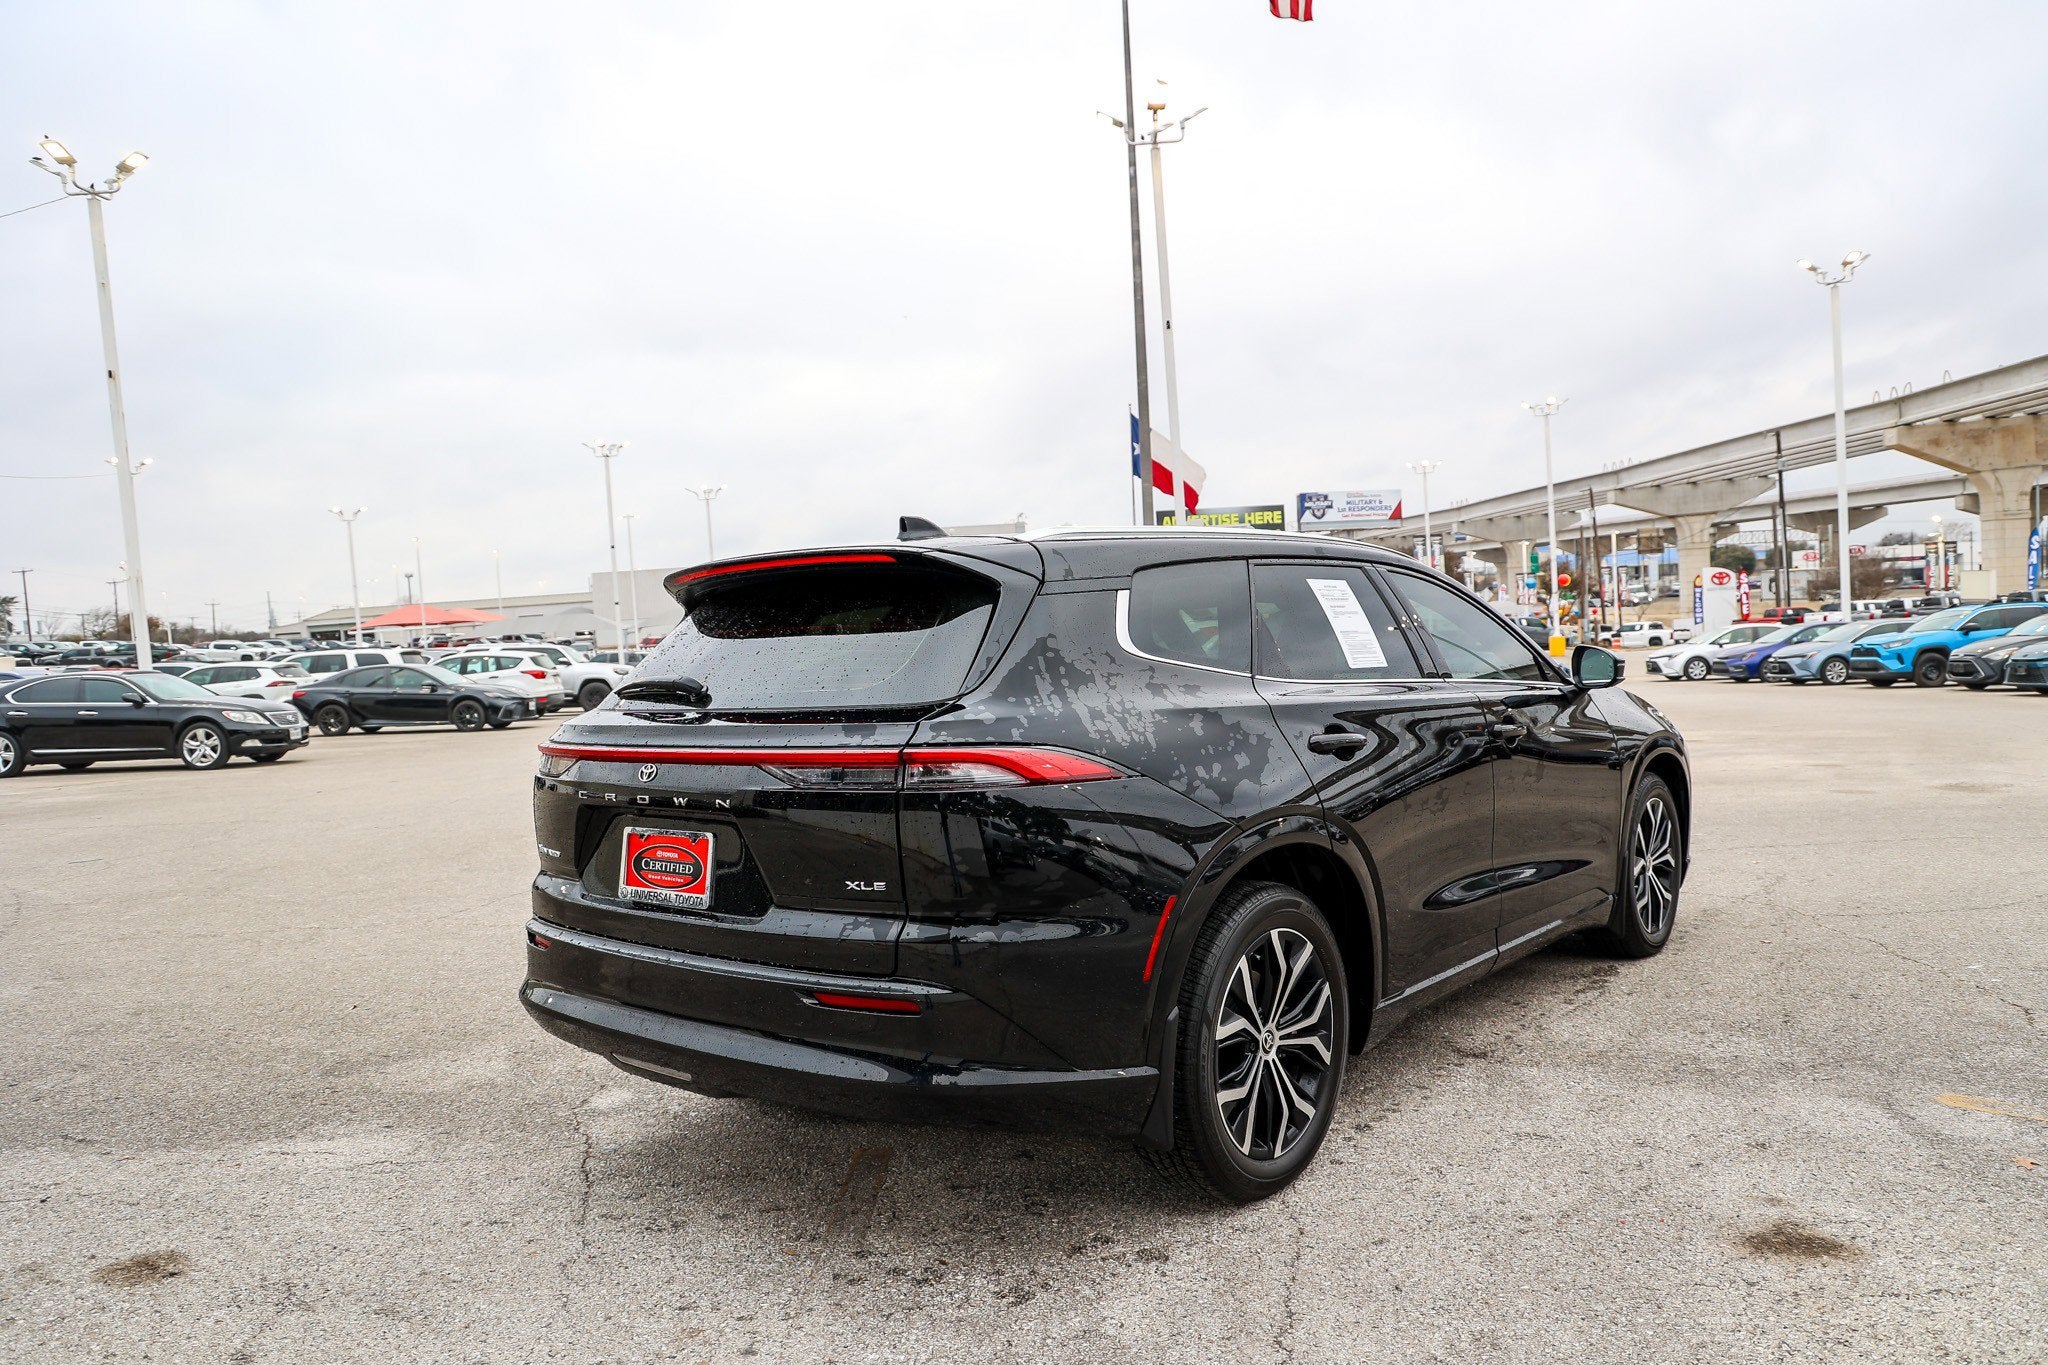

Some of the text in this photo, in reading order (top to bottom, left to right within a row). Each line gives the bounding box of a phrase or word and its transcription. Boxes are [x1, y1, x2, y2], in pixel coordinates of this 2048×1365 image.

[1244, 510, 1282, 524] HERE
[1740, 573, 1750, 615] SALE
[578, 790, 731, 809] CROWN
[844, 880, 887, 891] XLE
[630, 888, 704, 906] UNIVERSAL TOYOTA
